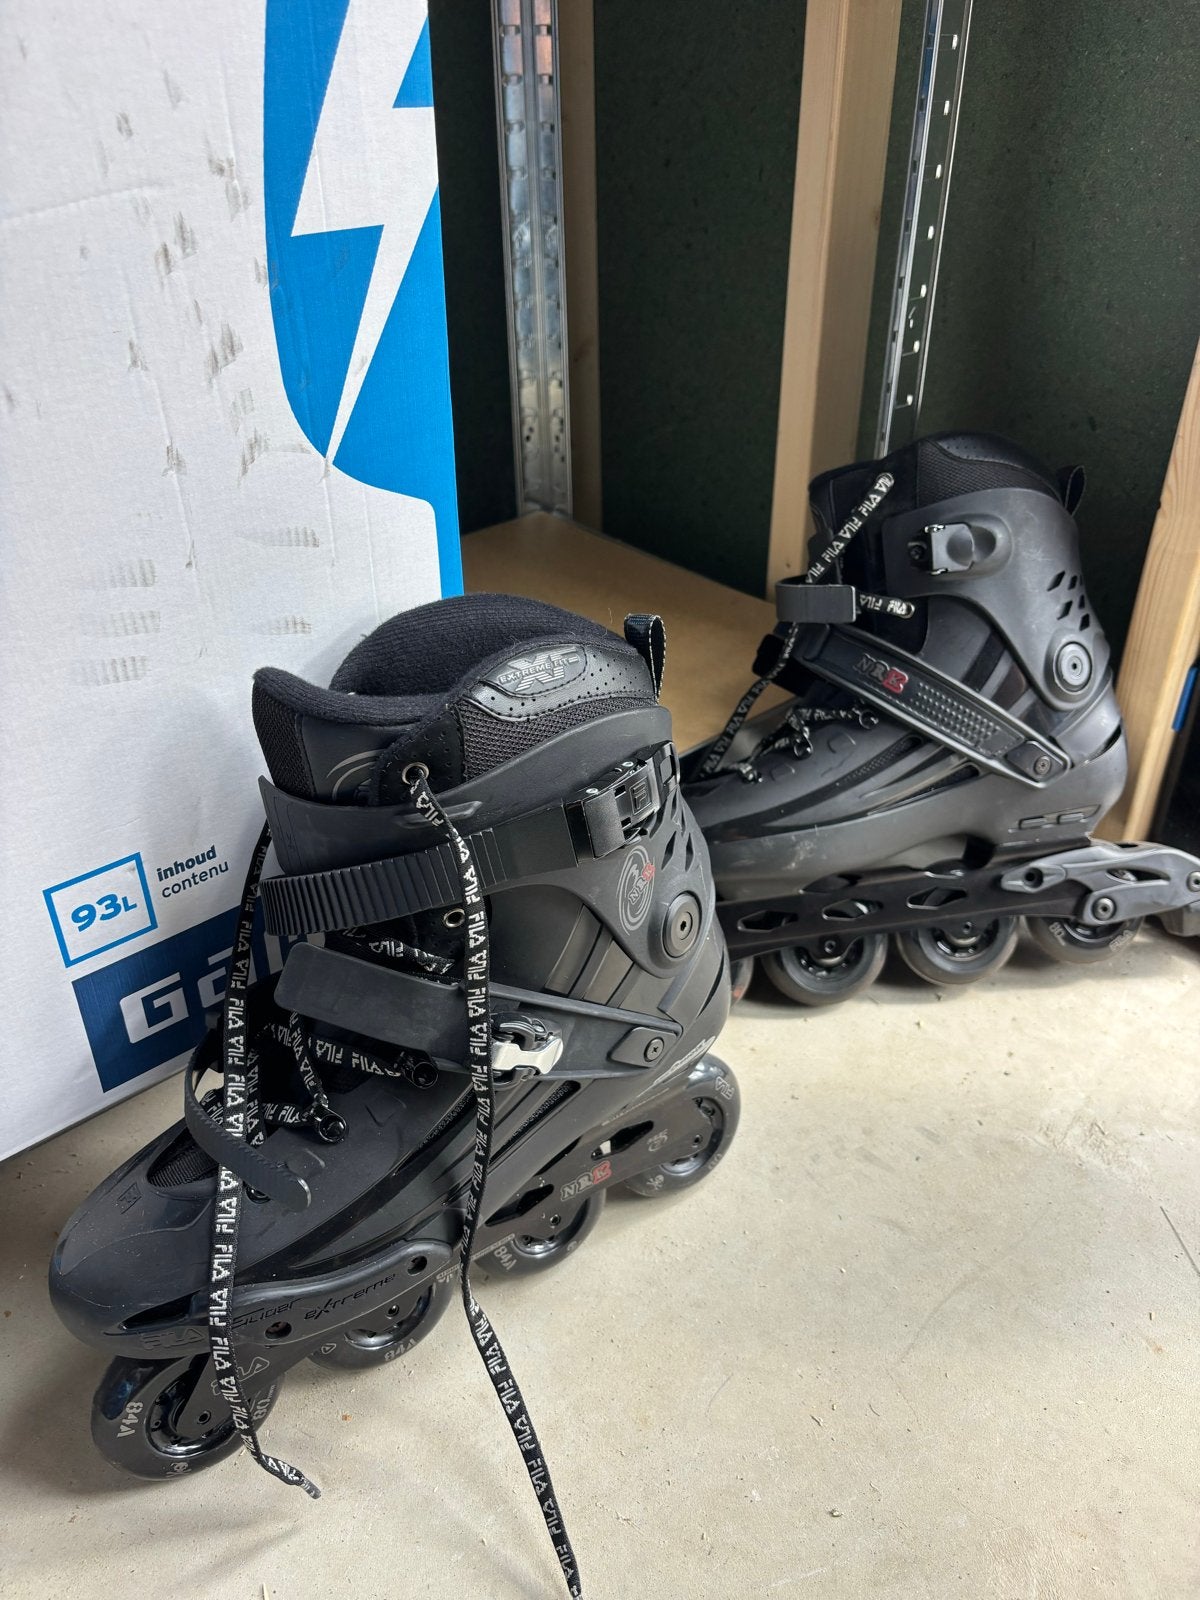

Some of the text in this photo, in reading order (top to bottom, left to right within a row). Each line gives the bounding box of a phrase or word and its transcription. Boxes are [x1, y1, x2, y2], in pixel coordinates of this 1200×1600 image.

[859, 494, 882, 517] FILA
[838, 517, 863, 539] FILA
[821, 541, 845, 563] FILA
[500, 662, 551, 684] EXTREME
[852, 653, 909, 694] NRK
[416, 791, 444, 827] FILA
[156, 845, 217, 882] inhoud
[162, 861, 229, 898] contenu
[464, 865, 481, 905] FILA
[71, 893, 138, 933] 93L
[468, 910, 487, 949] FILA
[237, 921, 253, 953] FILA
[230, 958, 250, 990] FILA
[467, 950, 487, 982] FILA
[228, 998, 245, 1030] FILA
[467, 987, 487, 1018] FILA
[228, 1035, 245, 1066] FILA
[469, 1022, 488, 1056] FILA
[315, 1039, 344, 1065] FILA
[351, 1051, 385, 1075] FILA
[227, 1073, 246, 1108] FILA
[471, 1064, 489, 1092] FILA
[226, 1112, 245, 1137] ILA
[278, 1105, 301, 1124] FILA
[476, 1097, 491, 1126] FILA
[474, 1128, 488, 1157] FILA
[471, 1161, 484, 1191] FILA
[561, 1160, 613, 1202] NRK
[216, 1197, 238, 1234] FILA
[211, 1244, 234, 1282] FILA
[493, 1246, 518, 1271] 84A
[209, 1287, 229, 1327] FILA
[474, 1314, 494, 1347] FILA
[211, 1336, 232, 1371] FILA
[484, 1342, 507, 1375] FILA
[219, 1375, 242, 1403] FILA
[497, 1378, 521, 1415] FILA
[117, 1401, 144, 1439] 84A
[230, 1405, 250, 1430] FILA
[514, 1414, 536, 1452] FILA
[527, 1458, 549, 1496] FILA
[543, 1497, 562, 1536] FILA
[556, 1544, 575, 1580] FILA
